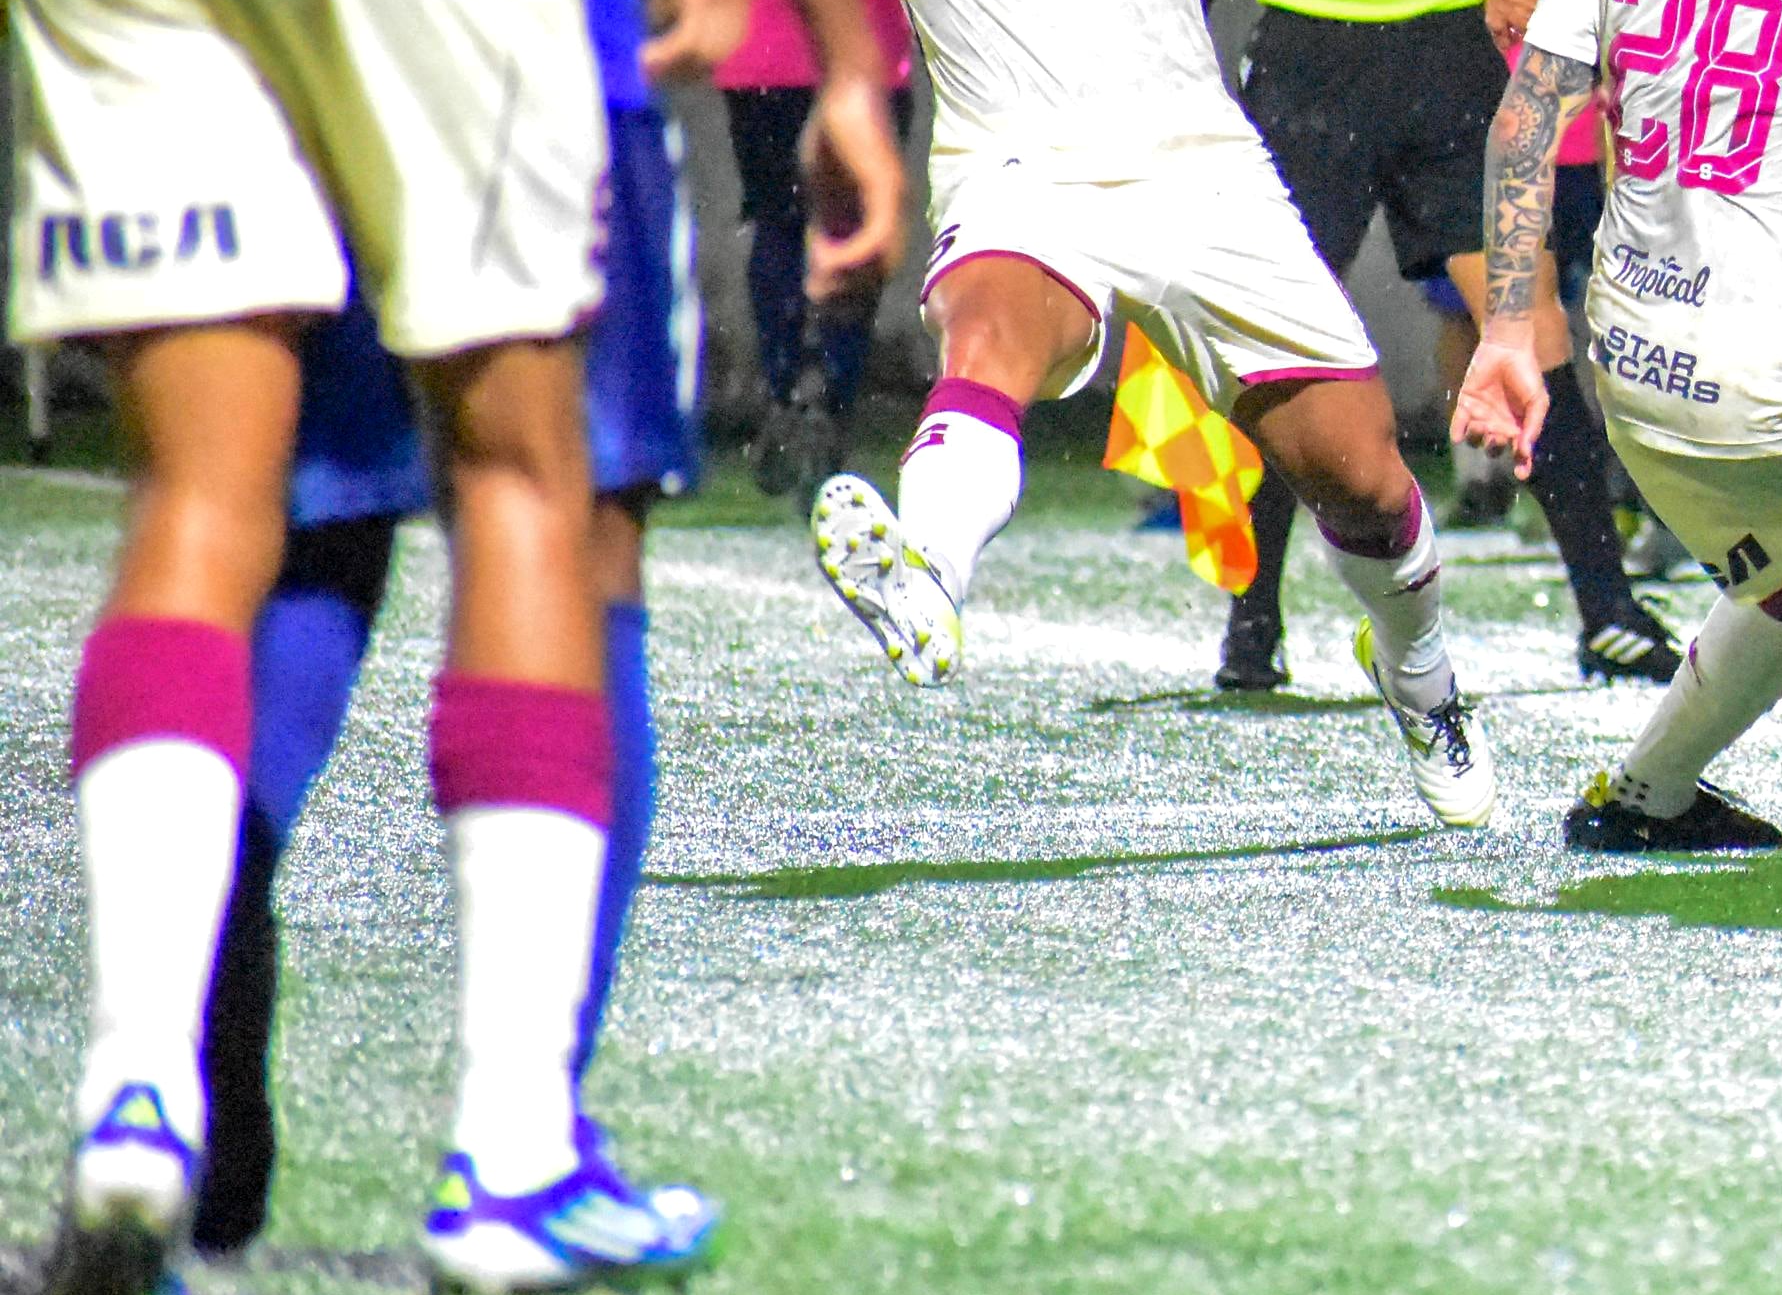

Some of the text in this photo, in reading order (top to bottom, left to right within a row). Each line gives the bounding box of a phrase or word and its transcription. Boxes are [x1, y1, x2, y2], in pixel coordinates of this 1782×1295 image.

[1613, 244, 1710, 307] Tropical
[1606, 325, 1697, 377] STAR
[1617, 355, 1721, 404] CARS
